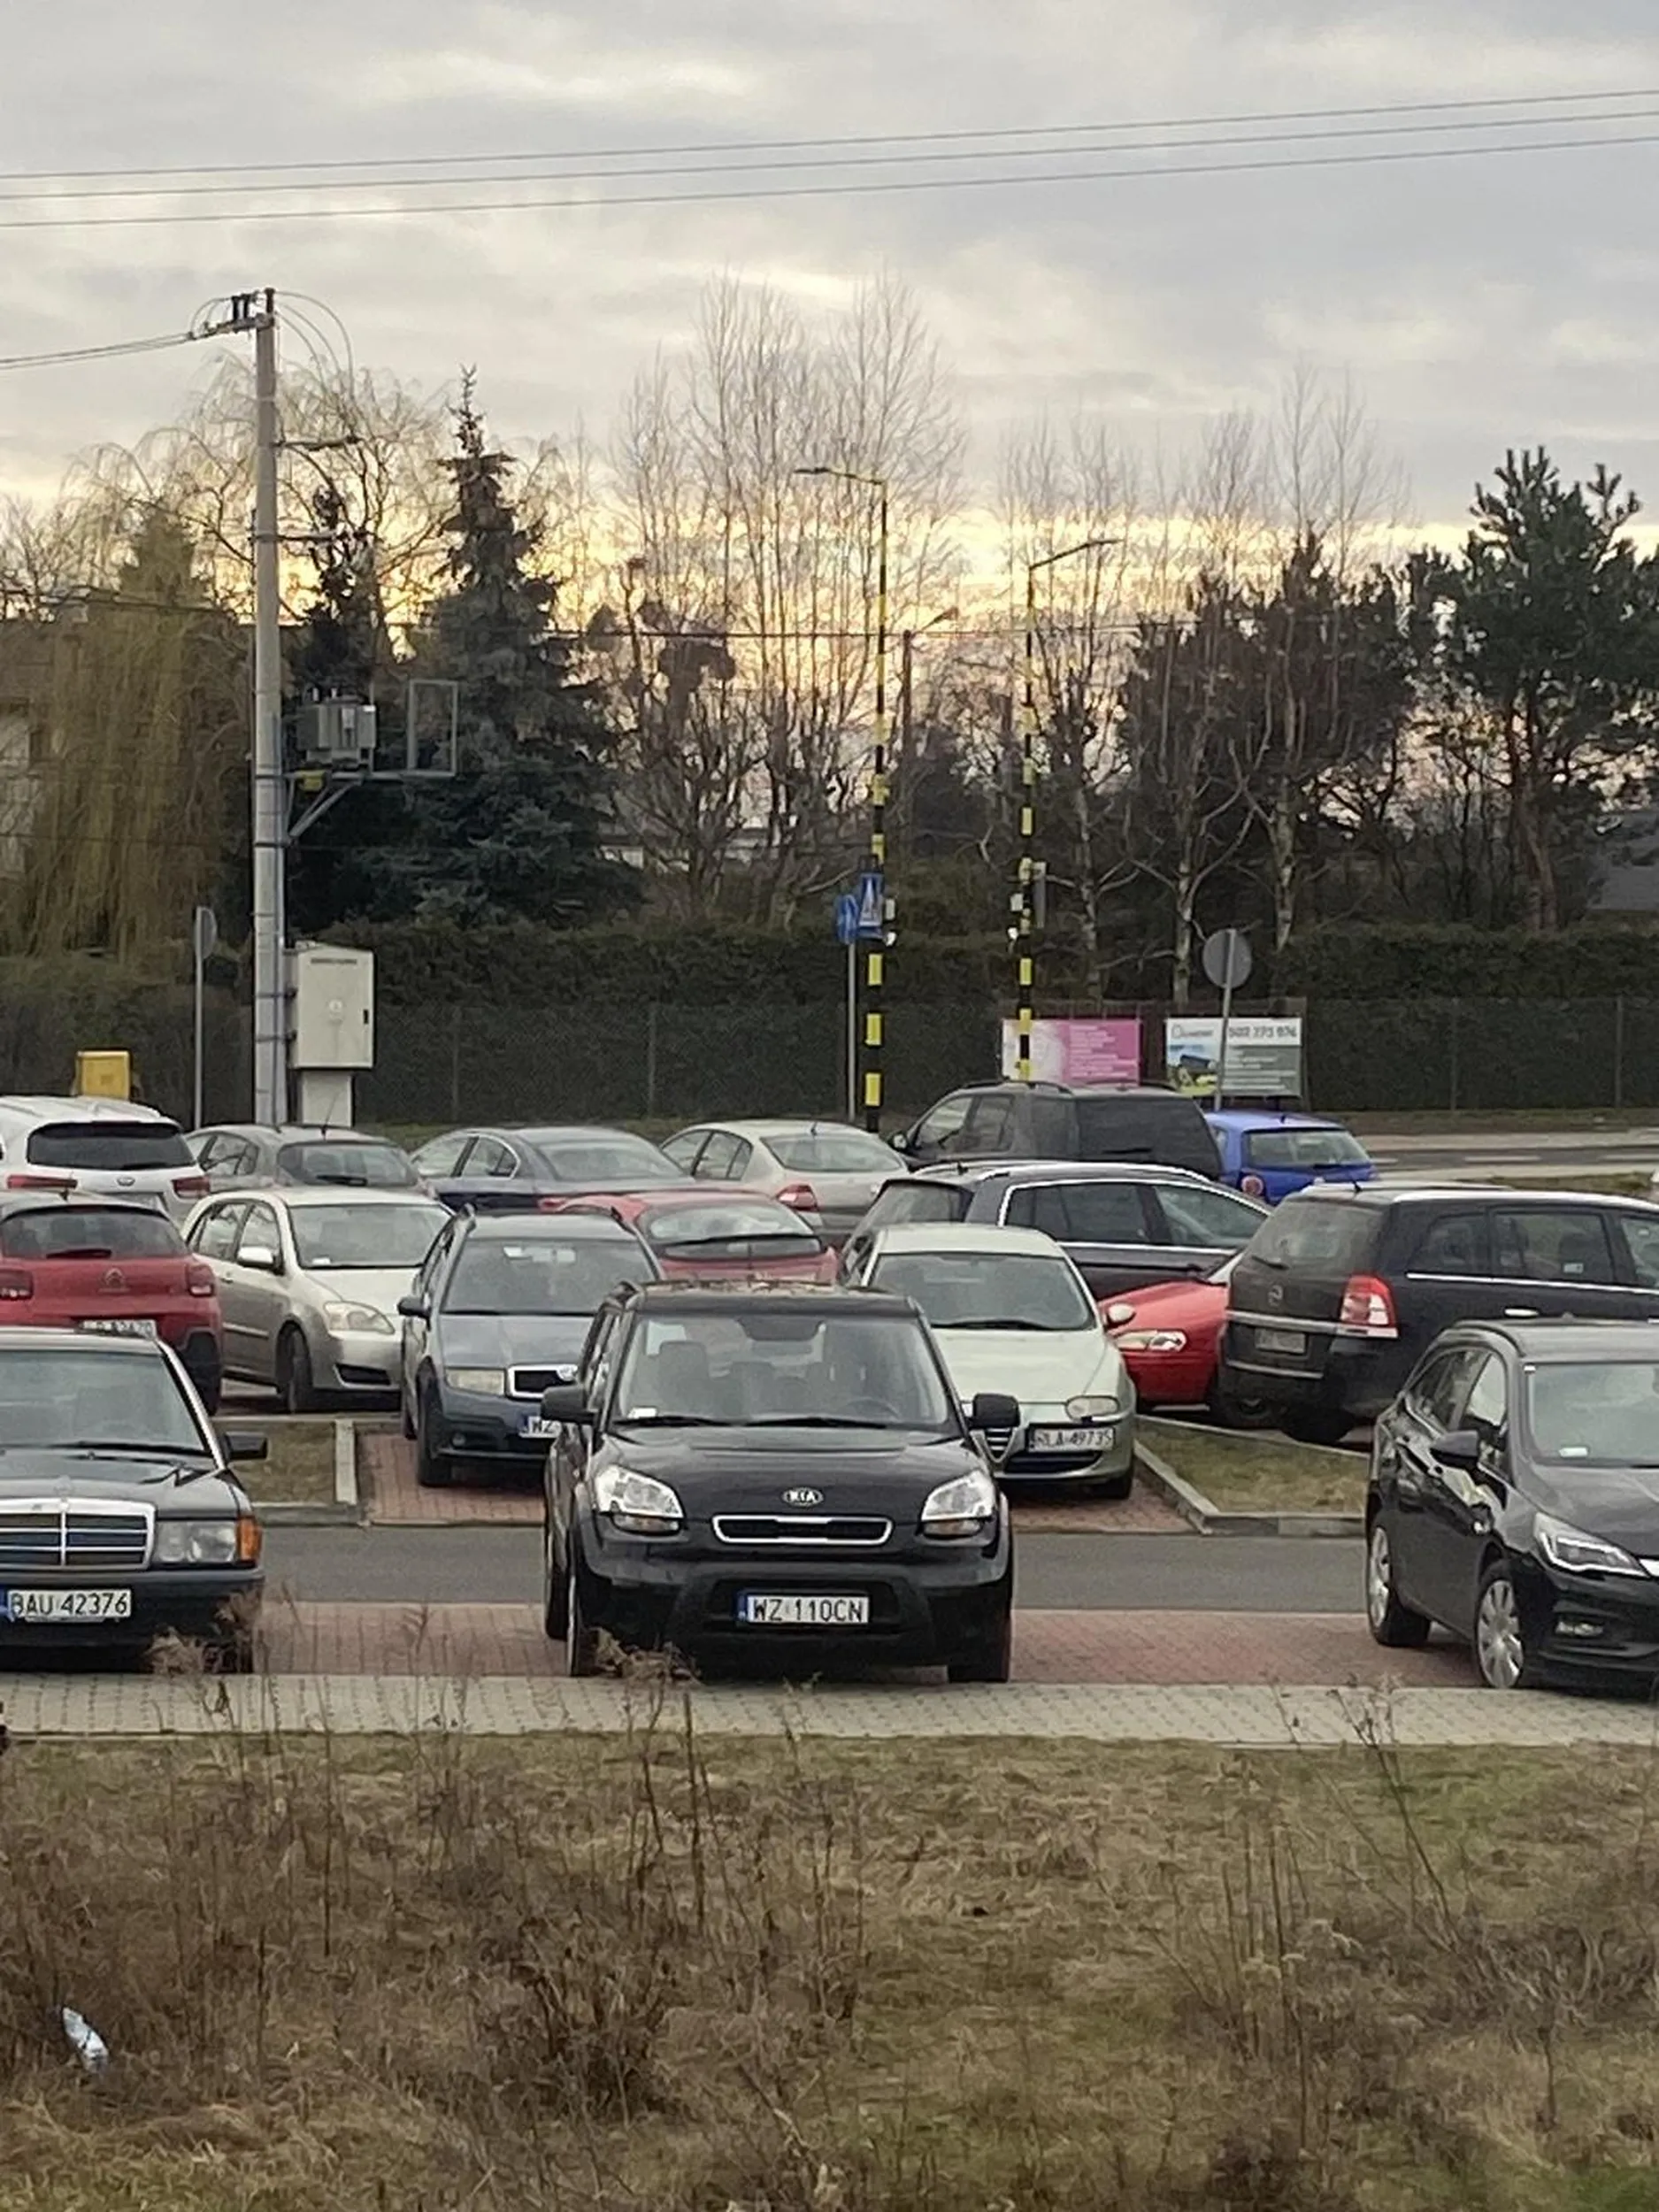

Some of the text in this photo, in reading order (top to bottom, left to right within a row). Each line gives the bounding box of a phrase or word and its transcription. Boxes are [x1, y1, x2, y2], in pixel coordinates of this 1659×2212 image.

[11, 1592, 128, 1616] BAU 42376
[753, 1598, 863, 1623] WZ 110CN
